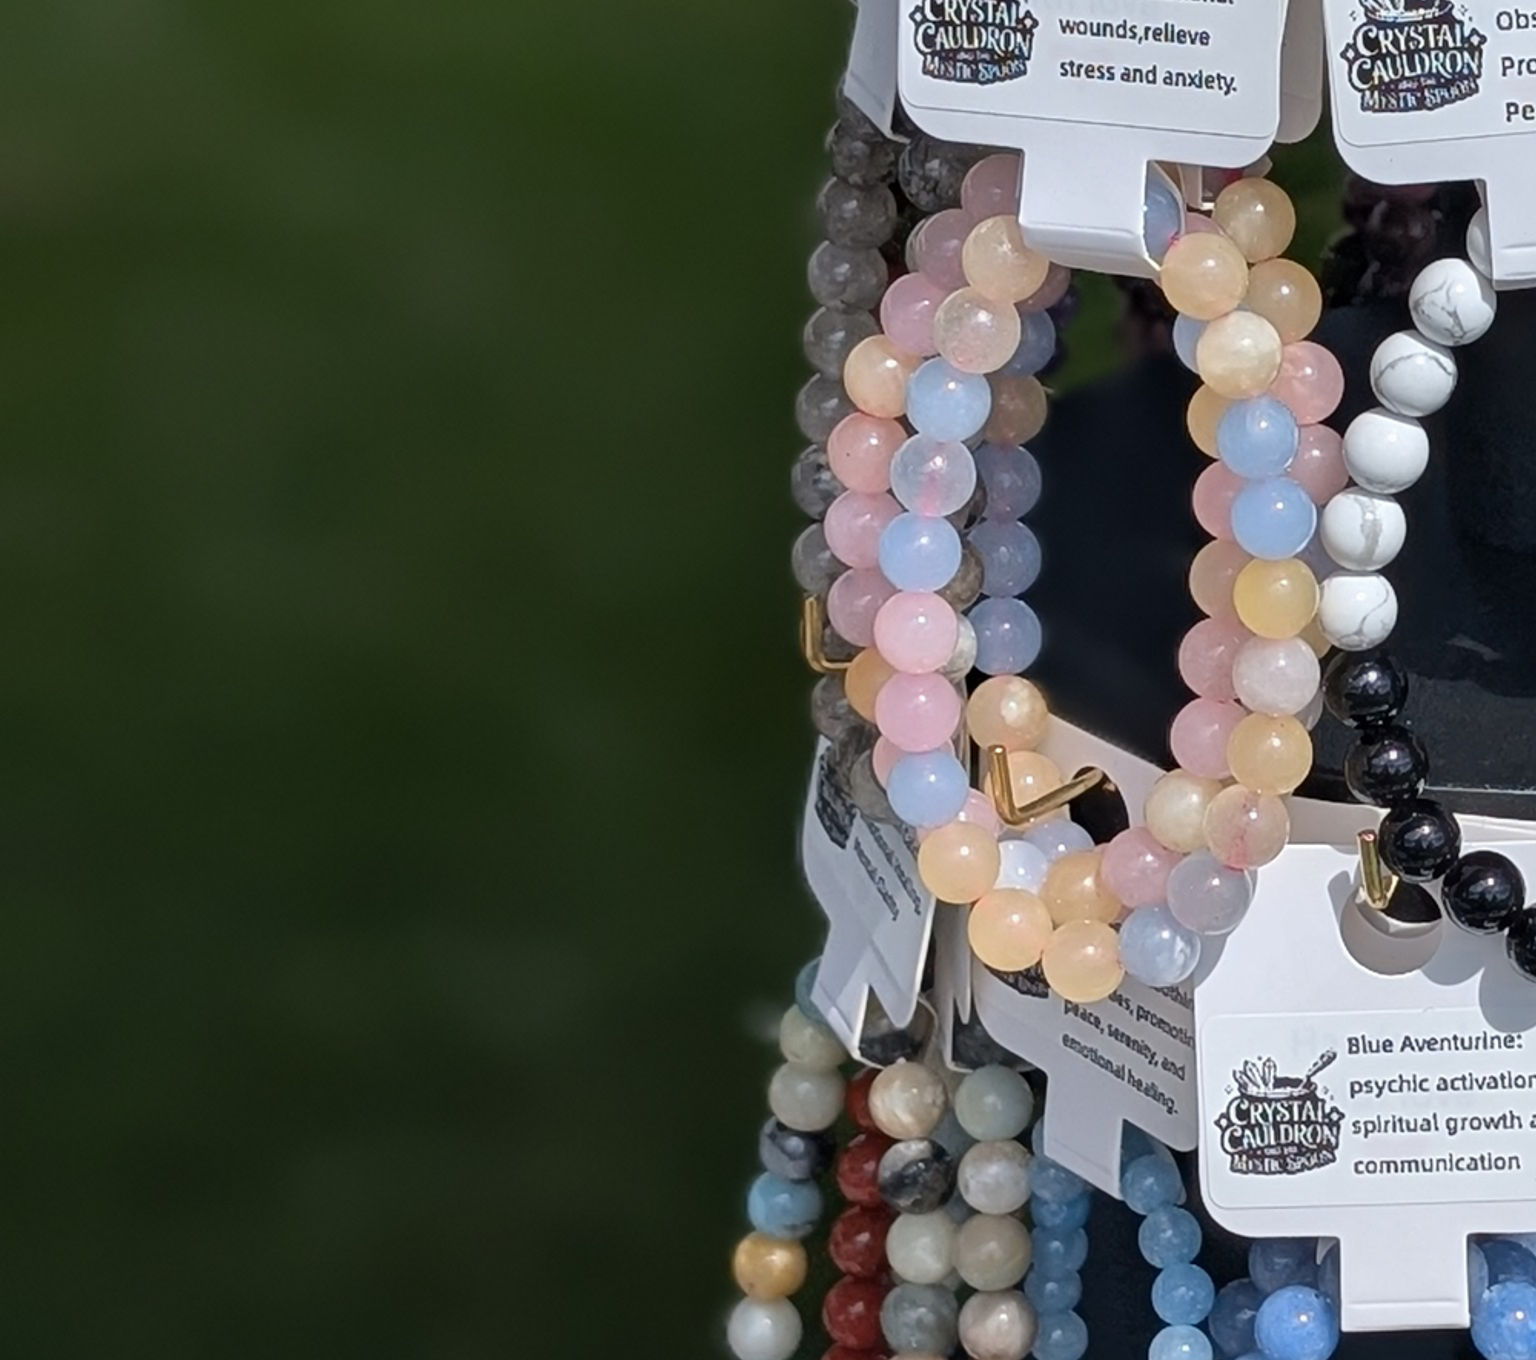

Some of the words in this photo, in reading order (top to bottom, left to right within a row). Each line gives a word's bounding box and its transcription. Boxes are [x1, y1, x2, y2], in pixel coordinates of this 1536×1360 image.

[916, 22, 1031, 58] CAULDRON
[1356, 24, 1469, 56] CRYSTAL
[1059, 60, 1115, 82] stress
[1120, 64, 1157, 86] and
[1162, 67, 1238, 96] anxiety.
[1351, 49, 1479, 90] CAULDRON
[1347, 1034, 1394, 1055] Blue
[1161, 1056, 1186, 1082] and
[1350, 1073, 1430, 1099] psychic
[1352, 1111, 1439, 1139] spiritual
[1446, 1110, 1523, 1136] growth
[1353, 1152, 1522, 1175] communication
